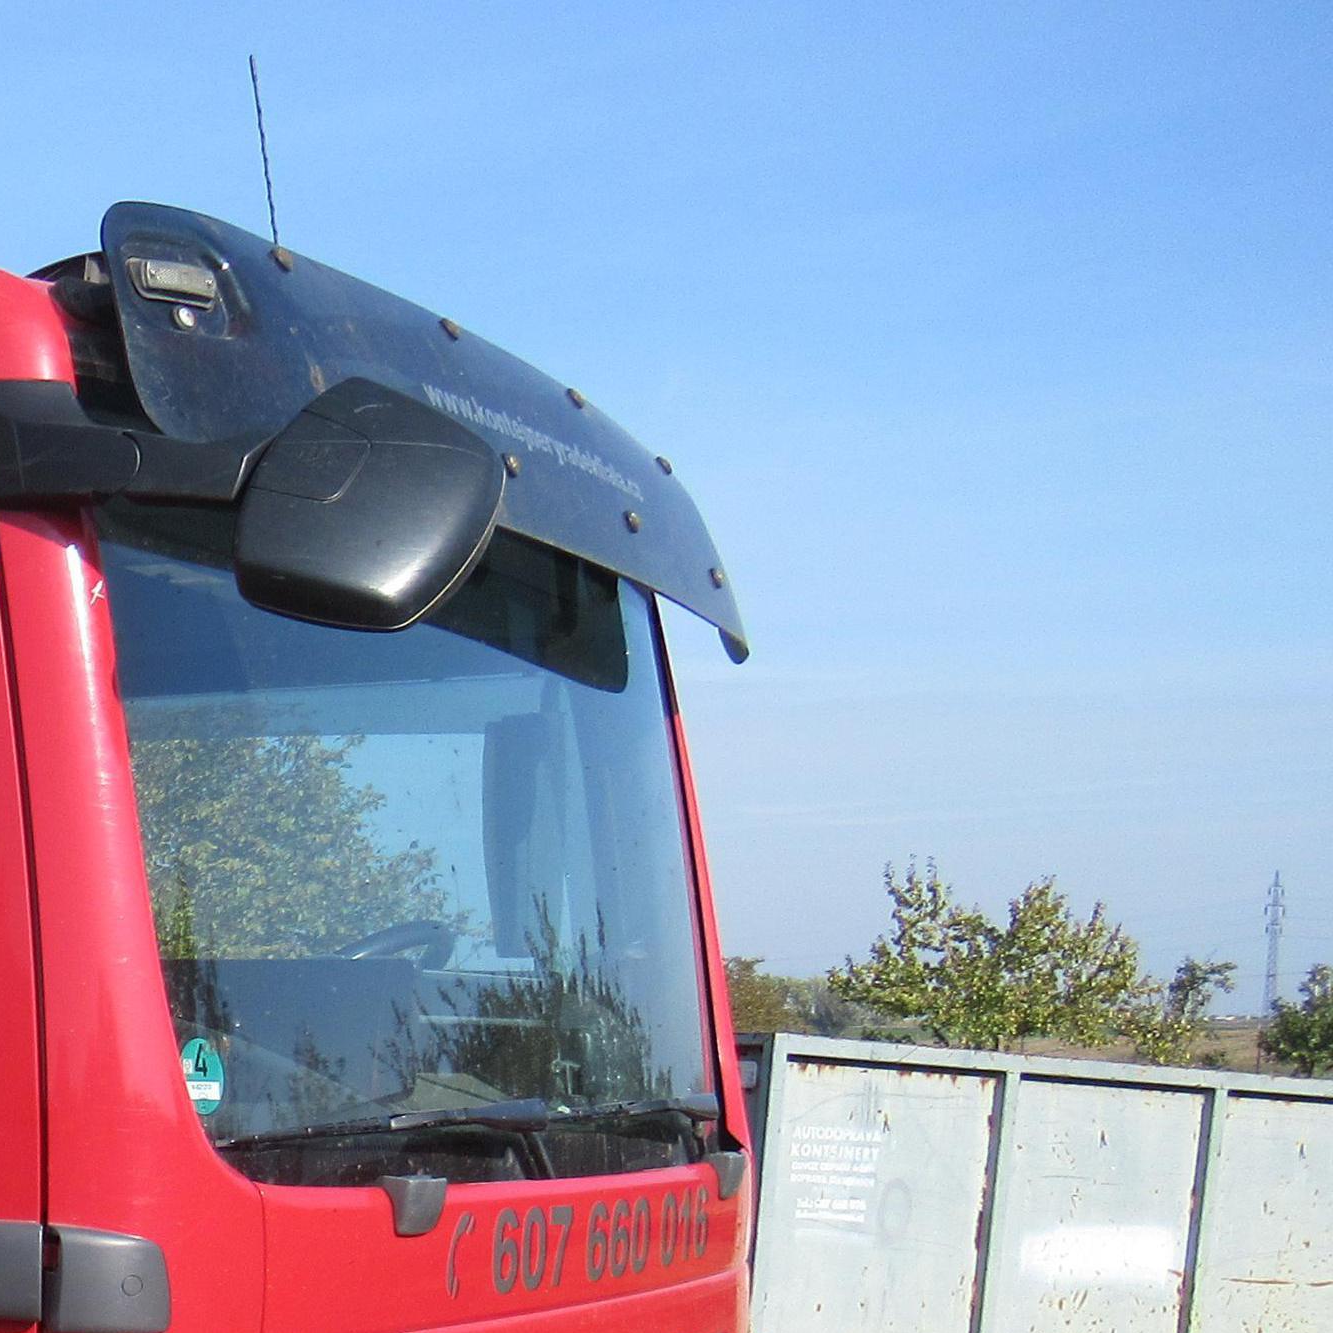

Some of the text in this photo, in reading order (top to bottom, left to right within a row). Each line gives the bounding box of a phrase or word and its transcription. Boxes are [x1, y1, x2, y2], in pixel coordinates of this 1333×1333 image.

[195, 1043, 208, 1077] 4
[492, 1186, 709, 1296] 607 660 016
